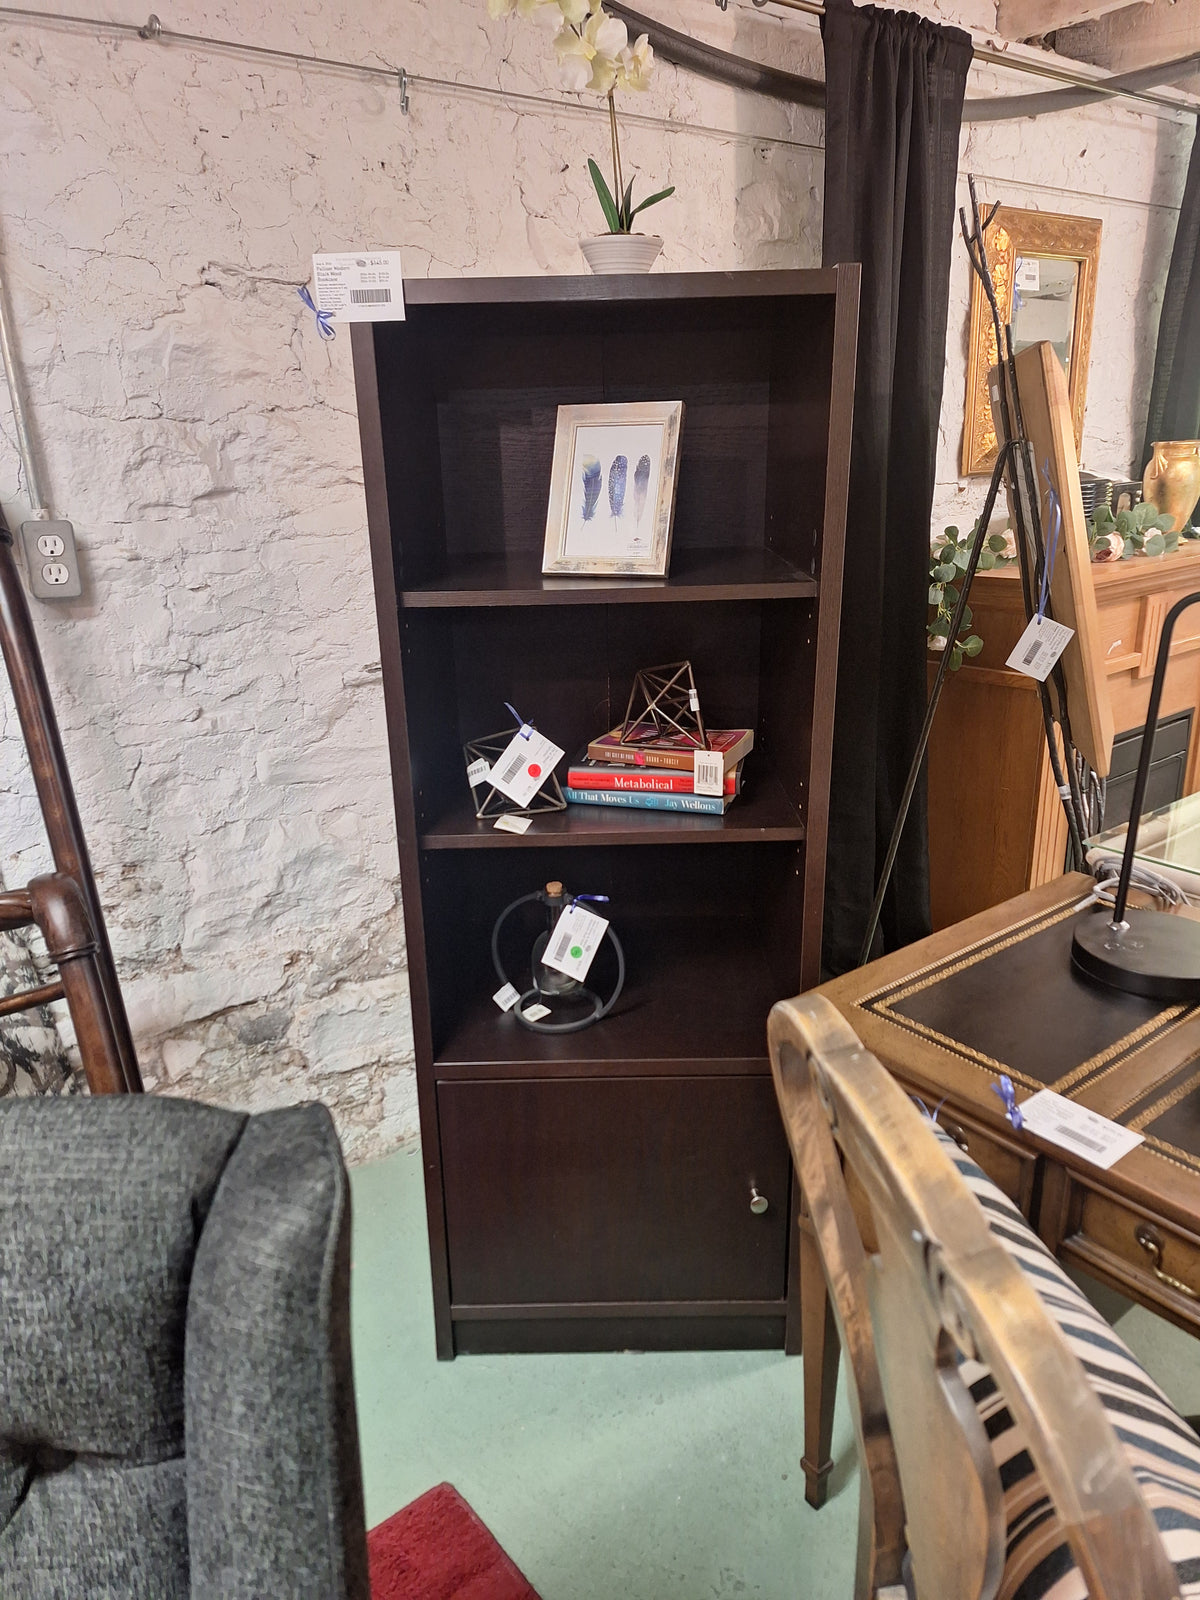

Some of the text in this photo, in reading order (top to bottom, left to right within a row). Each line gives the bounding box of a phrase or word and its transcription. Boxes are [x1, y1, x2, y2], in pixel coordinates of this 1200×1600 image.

[614, 777, 673, 790] Metabolical
[566, 790, 640, 805] All That Moves Us
[664, 798, 716, 811] Jay Wellons
